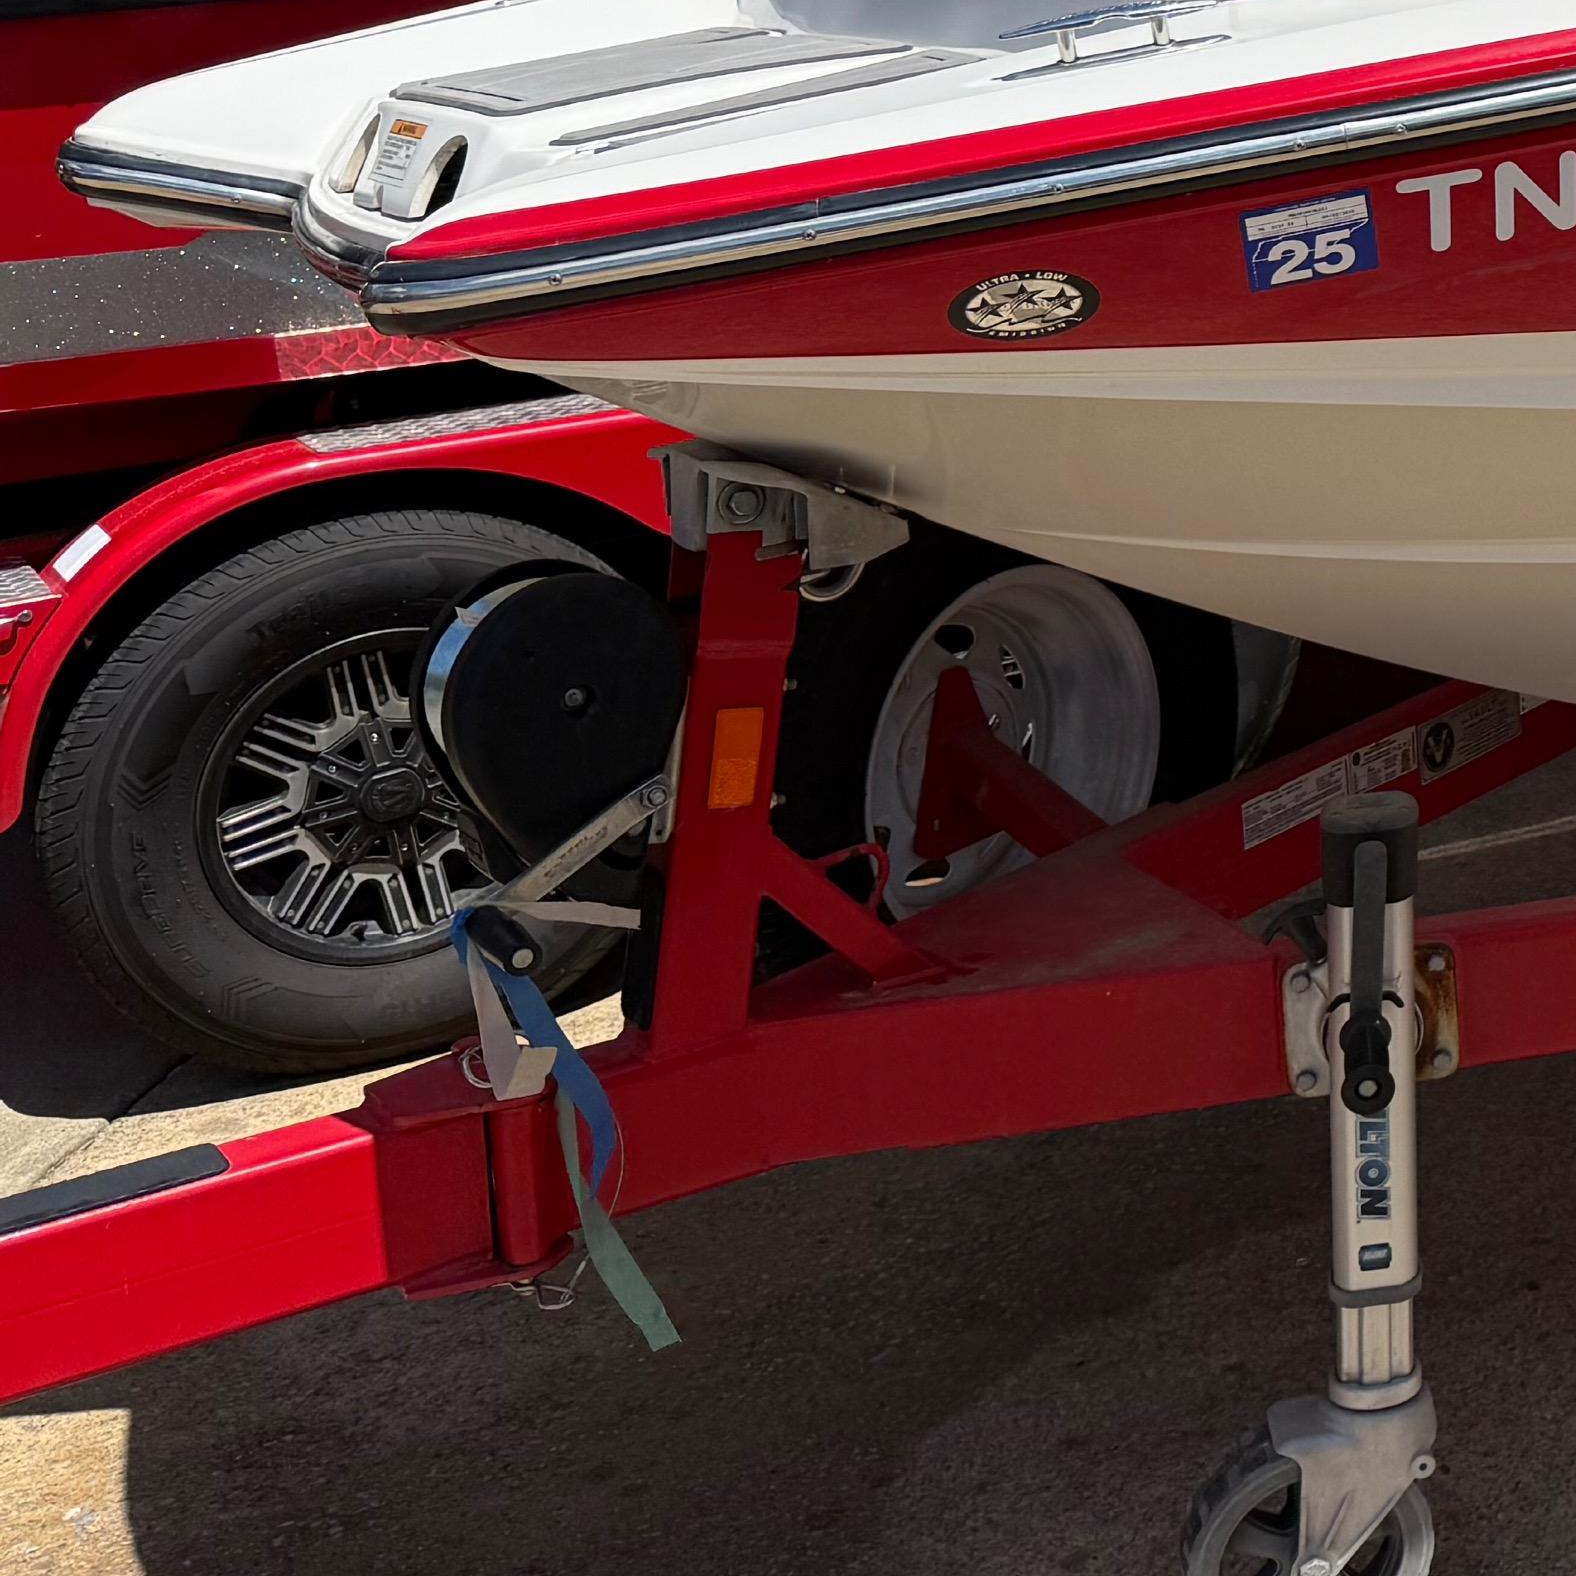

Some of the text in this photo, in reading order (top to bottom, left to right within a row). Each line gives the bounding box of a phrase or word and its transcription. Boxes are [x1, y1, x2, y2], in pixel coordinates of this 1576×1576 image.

[975, 271, 1068, 291] ULTRA LOW
[1267, 228, 1356, 285] 25
[1355, 1106, 1392, 1220] LTON
